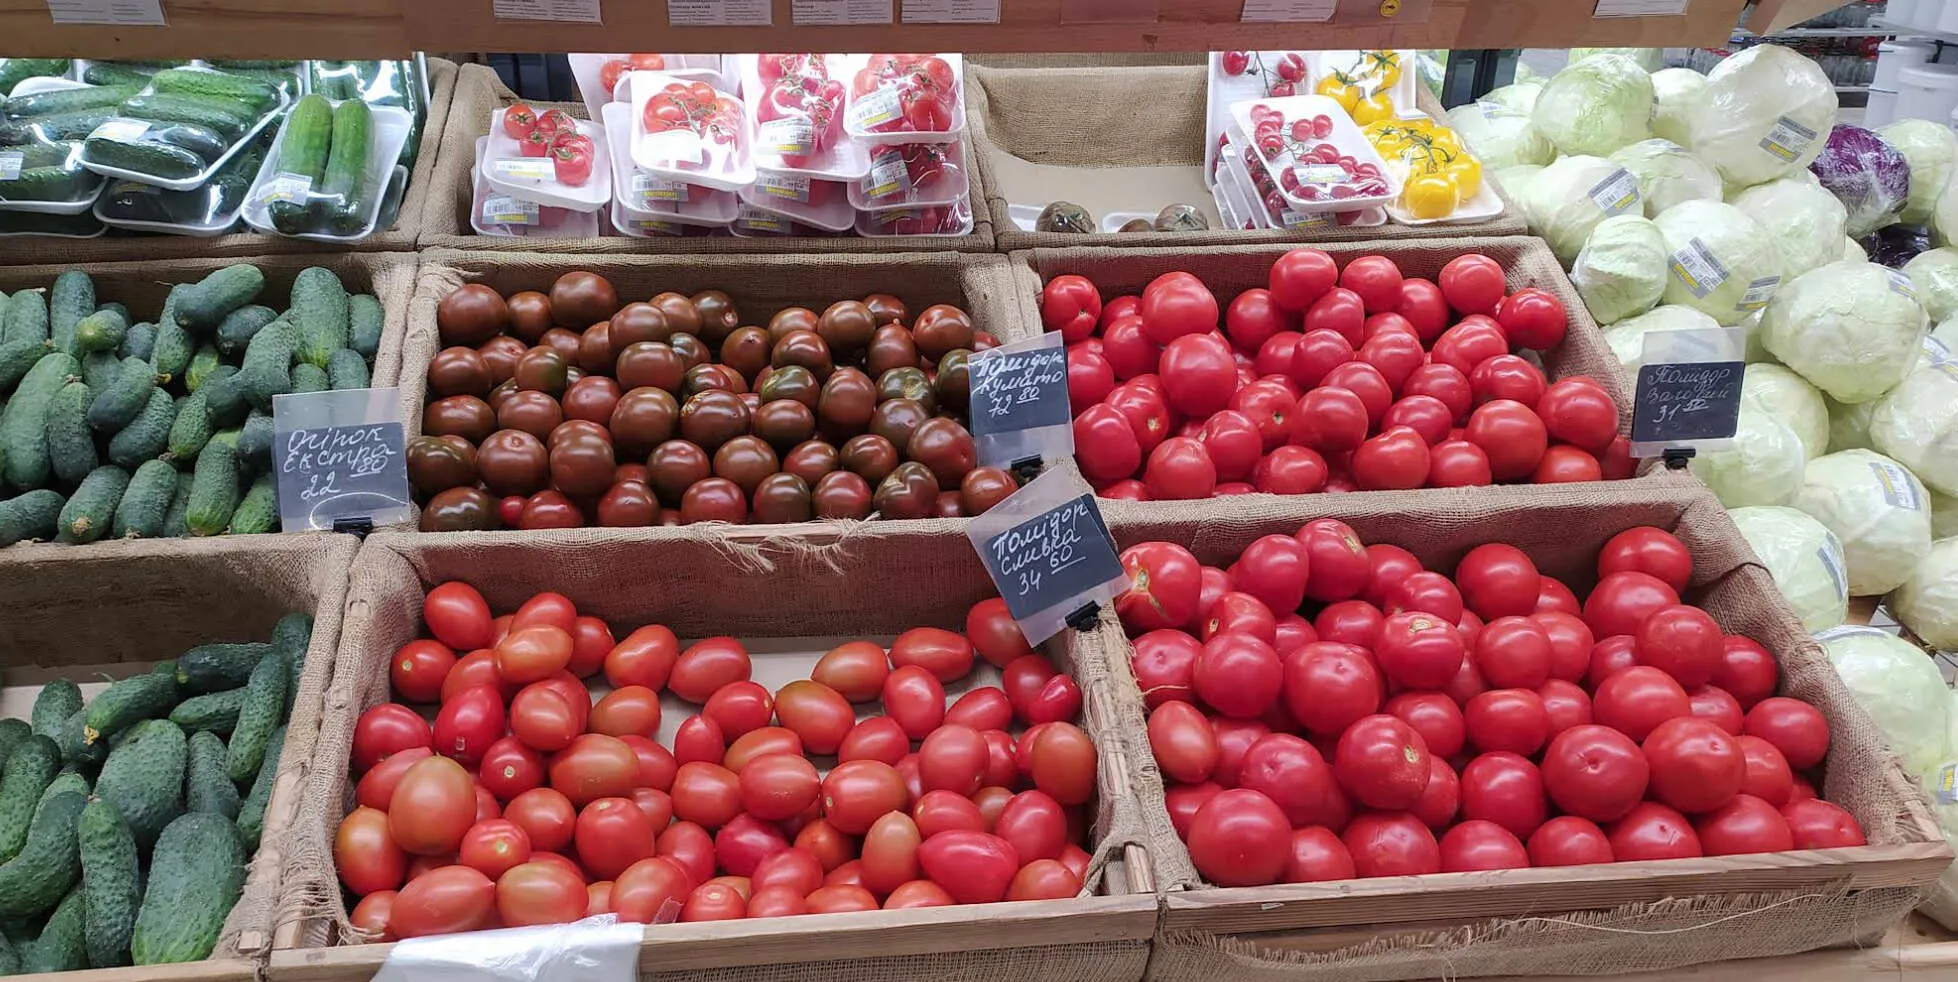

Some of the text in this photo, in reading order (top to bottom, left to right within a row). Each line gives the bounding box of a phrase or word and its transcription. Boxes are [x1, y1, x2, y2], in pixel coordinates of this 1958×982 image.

[988, 386, 1040, 418] 72 80
[1652, 404, 1682, 423] 31
[288, 427, 384, 458] Огірок
[300, 455, 389, 500] 22 80
[992, 503, 1089, 560] Помідор
[1001, 528, 1082, 576] Сливка
[1019, 545, 1073, 596] 34 60
